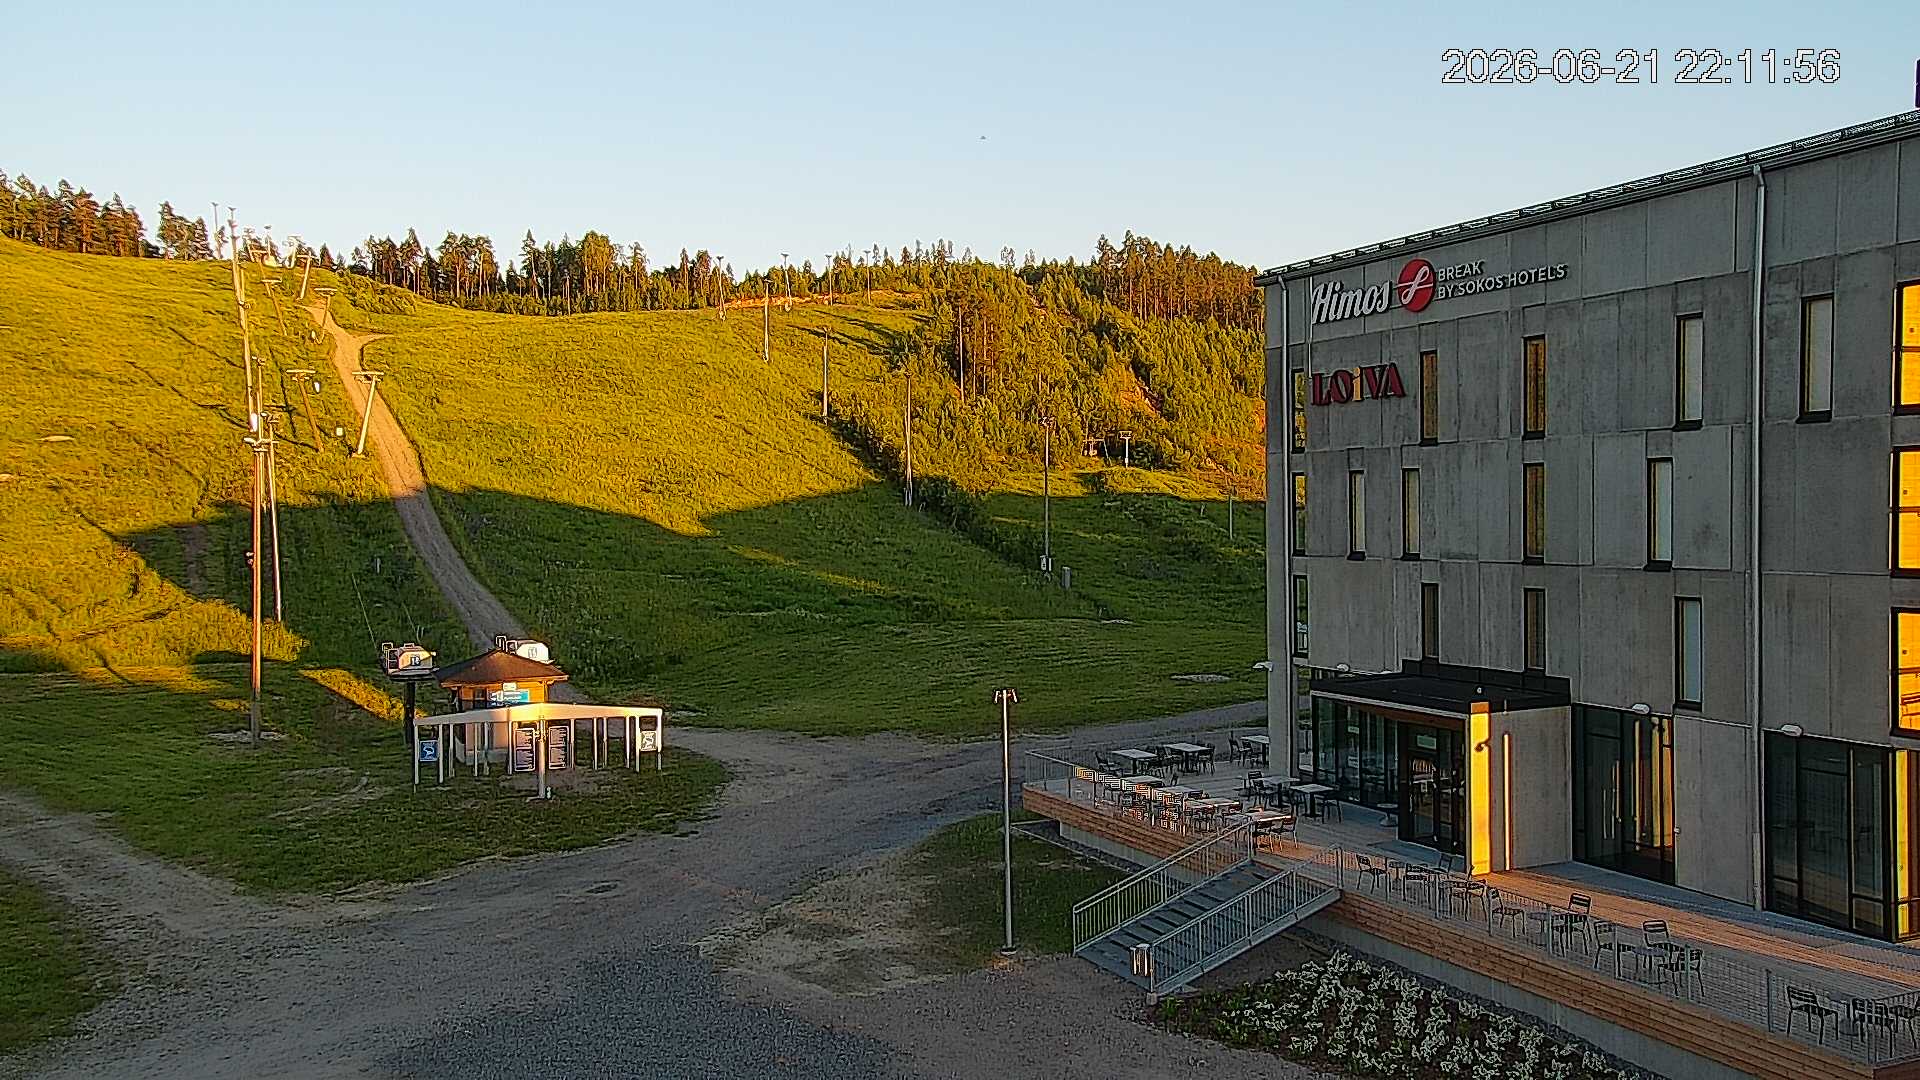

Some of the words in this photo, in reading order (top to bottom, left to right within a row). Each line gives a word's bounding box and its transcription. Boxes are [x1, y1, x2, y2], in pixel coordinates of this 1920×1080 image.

[1438, 260, 1482, 281] BREAK
[1438, 285, 1454, 300] BY
[1458, 276, 1504, 297] SOKOS
[1508, 264, 1566, 287] HOTELS
[1311, 280, 1390, 324] Himos
